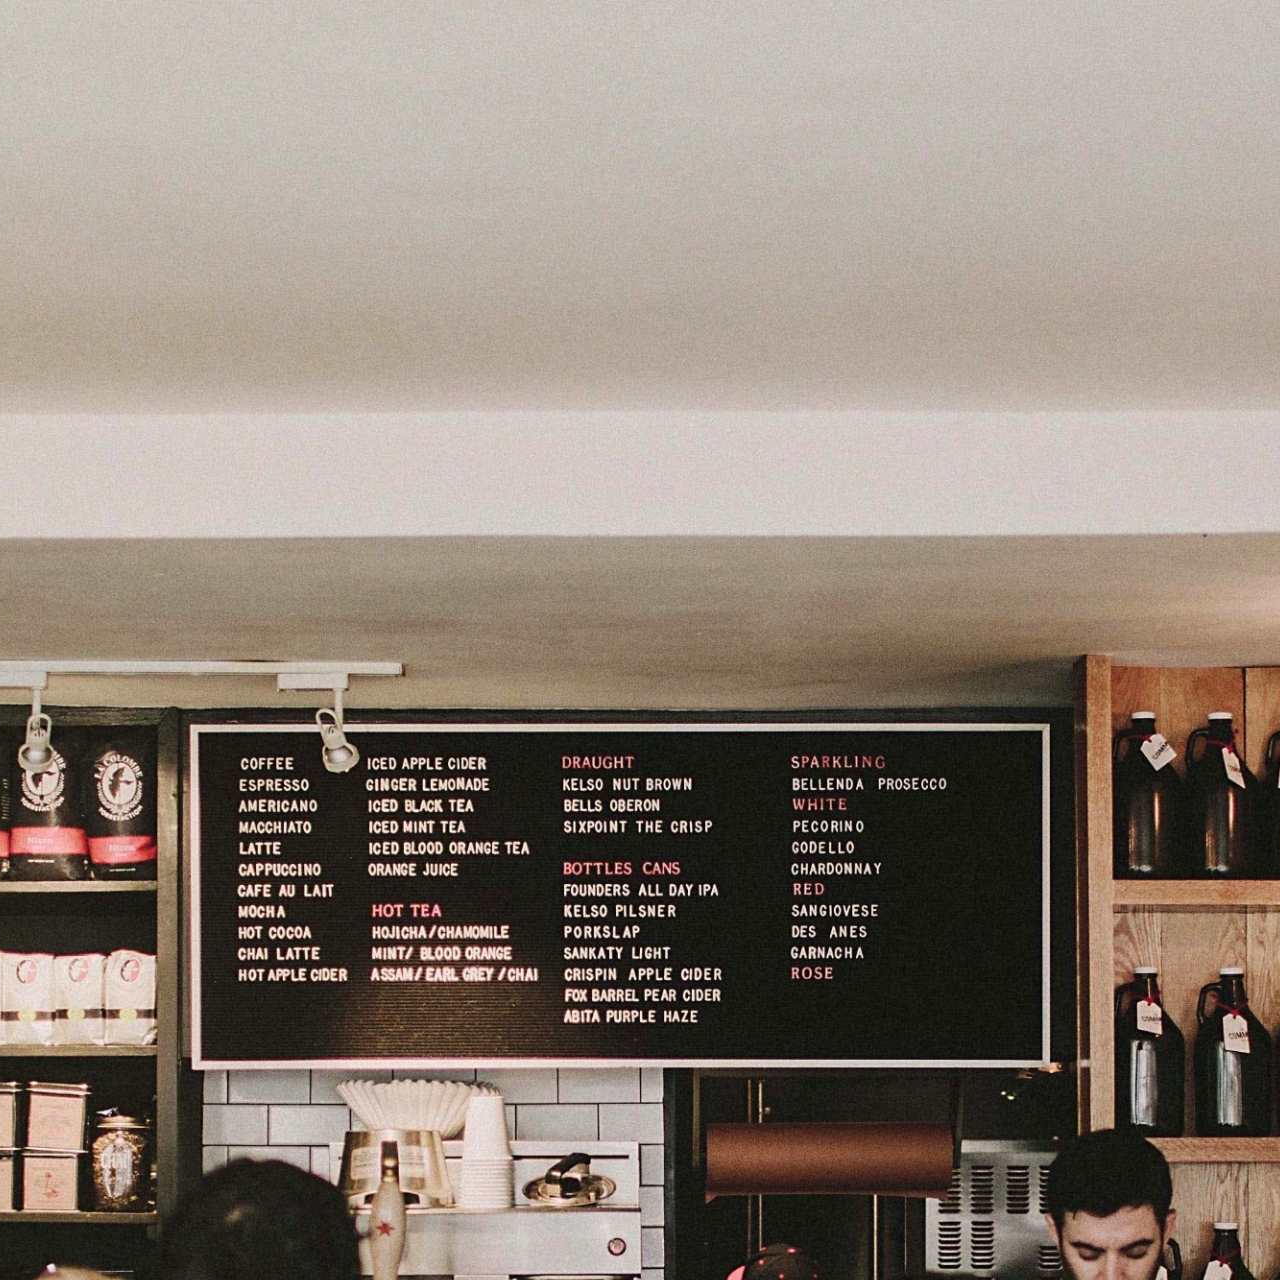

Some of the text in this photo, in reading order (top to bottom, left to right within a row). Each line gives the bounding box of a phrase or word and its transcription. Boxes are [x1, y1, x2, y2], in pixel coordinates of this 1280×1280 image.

[103, 754, 144, 778] COLOMBE
[241, 757, 293, 770] COFFEE
[368, 757, 486, 770] ICED APPLE CIDER
[562, 756, 634, 769] DRAUGHT
[792, 756, 885, 768] SPARKLING
[240, 779, 309, 791] ESPRESSO
[366, 777, 489, 791] GINGER LEMONADE
[563, 778, 692, 791] KELSO NUT BROWN
[793, 778, 946, 790] BELLENDA PROSECCO
[239, 799, 317, 812] AMERICANO
[369, 799, 474, 812] ICED BLACK TEA
[564, 799, 659, 812] BELLS OBERON
[793, 798, 846, 810] WHITE
[239, 821, 311, 833] MACCHIATO
[369, 820, 465, 833] ICED MINT TEA
[564, 820, 712, 833] SIXPOINT THE CRISP
[793, 820, 863, 832] PECORINO
[240, 842, 281, 854] LATTE
[369, 841, 529, 855] ICED BLOOD ORANGE TEA
[792, 841, 854, 854] GODELLO
[239, 863, 321, 876] CAPPUCCINO
[368, 863, 458, 876] ORANGE JUICE
[564, 862, 680, 875] BOTTLES CANS
[791, 863, 881, 875] CHARDONNAY
[238, 884, 334, 897] CAFE AU LAIT
[564, 884, 718, 896] FOUNDERS ALL DAY IPA
[793, 883, 824, 895] RED
[239, 905, 285, 918] MOCHA
[372, 904, 441, 917] HOT TEA
[564, 905, 675, 917] KELSO PILSNER
[792, 904, 878, 917] SANGIOVESE
[239, 926, 311, 939] HOT COCOA
[373, 925, 509, 939] HOJICHA/CHAMOMILE
[564, 925, 640, 938] PORKSLAP
[792, 925, 867, 938] DES ANES
[238, 947, 320, 960] CHAI LATTE
[372, 946, 512, 960] MINT/ BLOOD ORANGE
[564, 946, 670, 959] SANKATY LIGHT
[791, 946, 863, 959] GARNACHA
[239, 968, 347, 981] HOT APPLE CIDER
[371, 967, 538, 982] ASSAM/ EARL GREY /CHAI
[565, 968, 721, 981] CRISPIN APPLE CIDER
[792, 967, 832, 979] ROSE
[565, 989, 720, 1002] FOX BARREL PEAR CIDER
[564, 1009, 698, 1023] ABITA PURPLE HAZE
